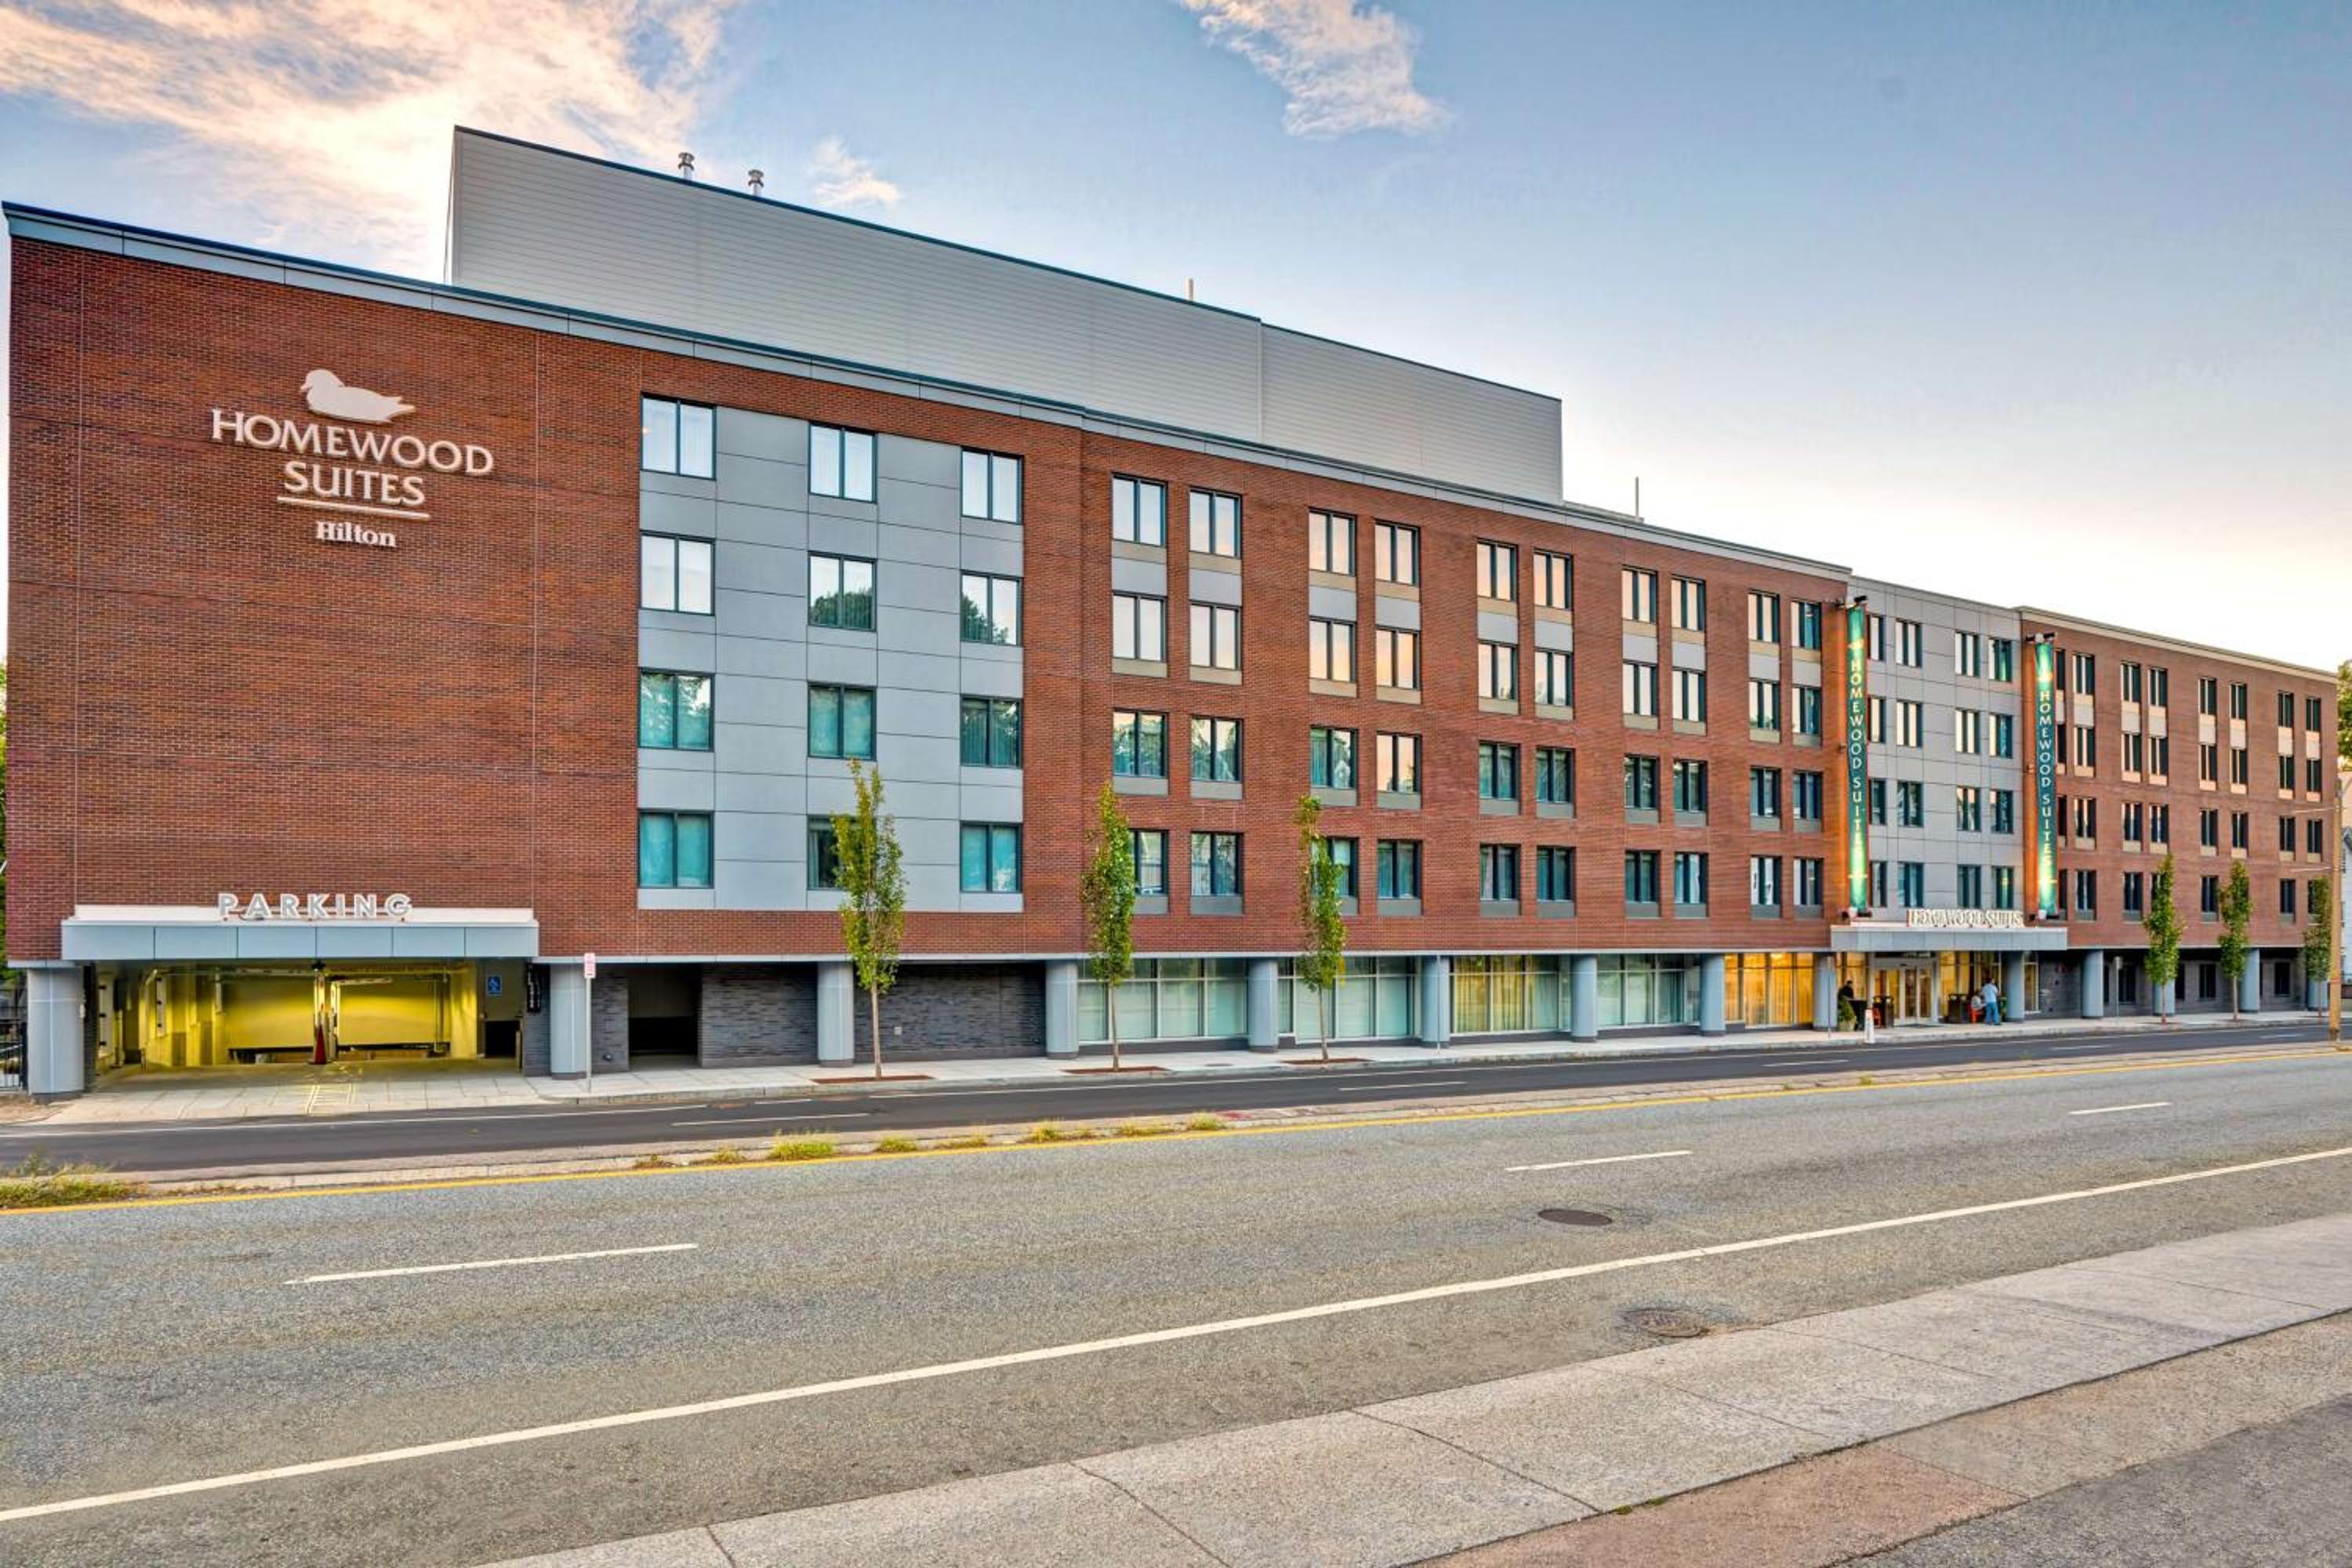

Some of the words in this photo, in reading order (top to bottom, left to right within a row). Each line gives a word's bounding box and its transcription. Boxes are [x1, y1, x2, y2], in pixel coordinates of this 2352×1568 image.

[211, 409, 494, 475] HOMEWOOD
[284, 460, 426, 506] SUITES
[315, 521, 396, 547] Hilton
[1849, 659, 1864, 770] HOMEWOOD
[2039, 690, 2053, 788] HOMEWOOD
[2042, 794, 2053, 866] SUITES
[218, 893, 412, 917] PARKING
